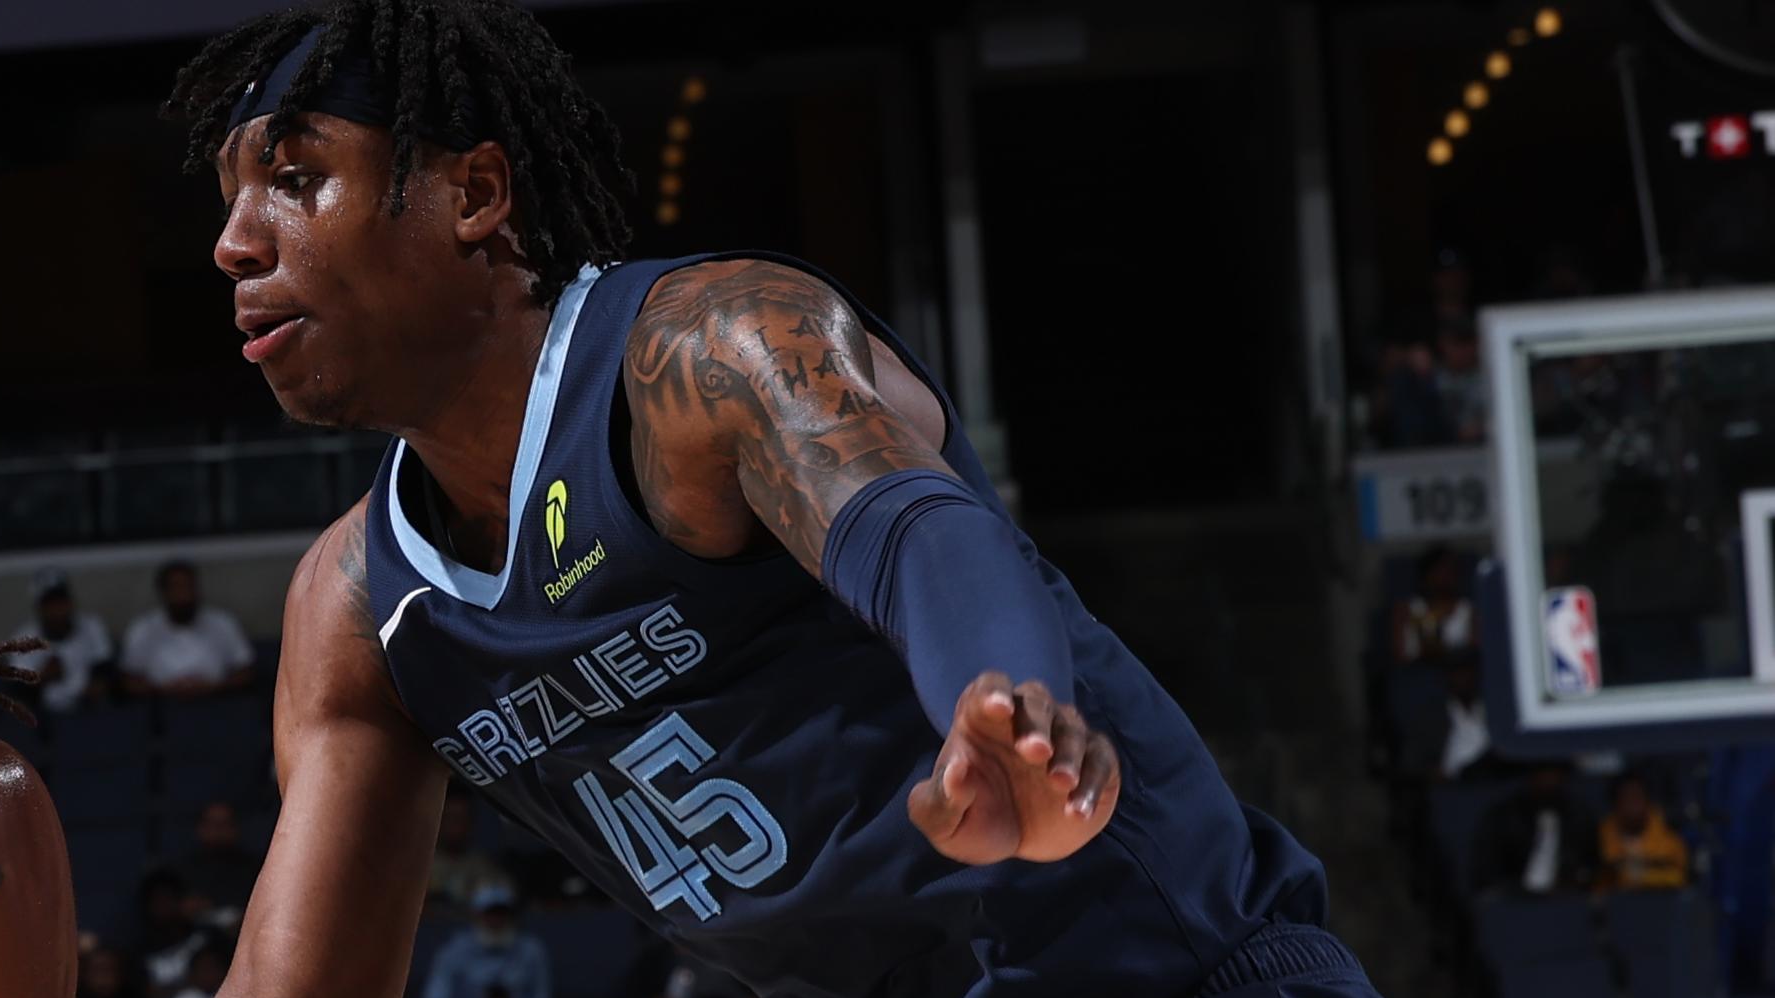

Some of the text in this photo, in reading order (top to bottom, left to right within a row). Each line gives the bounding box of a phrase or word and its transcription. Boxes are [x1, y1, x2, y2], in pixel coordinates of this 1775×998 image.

[1405, 476, 1489, 526] 109
[544, 537, 606, 605] Robinhood
[572, 711, 789, 923] 45
